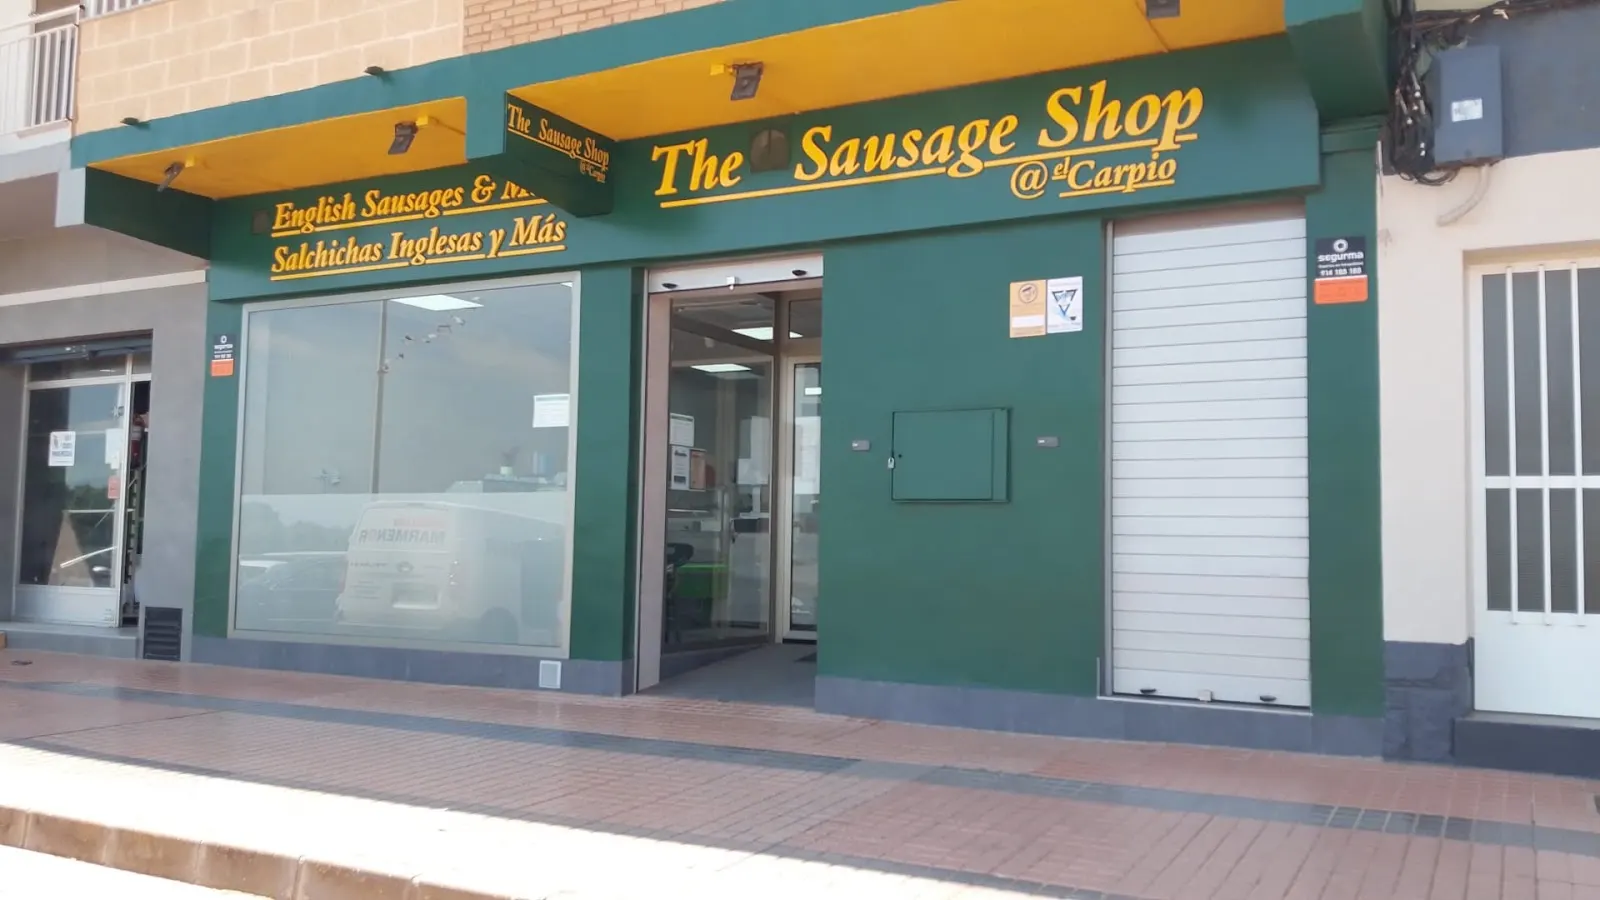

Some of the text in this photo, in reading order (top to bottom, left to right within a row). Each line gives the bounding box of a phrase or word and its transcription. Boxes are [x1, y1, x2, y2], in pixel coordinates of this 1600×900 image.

[507, 103, 610, 171] The Sausage Shop
[651, 79, 1204, 196] The Sausage Shop
[272, 192, 356, 233] English
[361, 186, 465, 218] Sausages
[471, 174, 497, 203] &
[1010, 160, 1049, 200] @
[1067, 152, 1178, 193] Carpio
[271, 212, 567, 273] Salchichas Inglesas y Más
[1317, 251, 1364, 263] segurma
